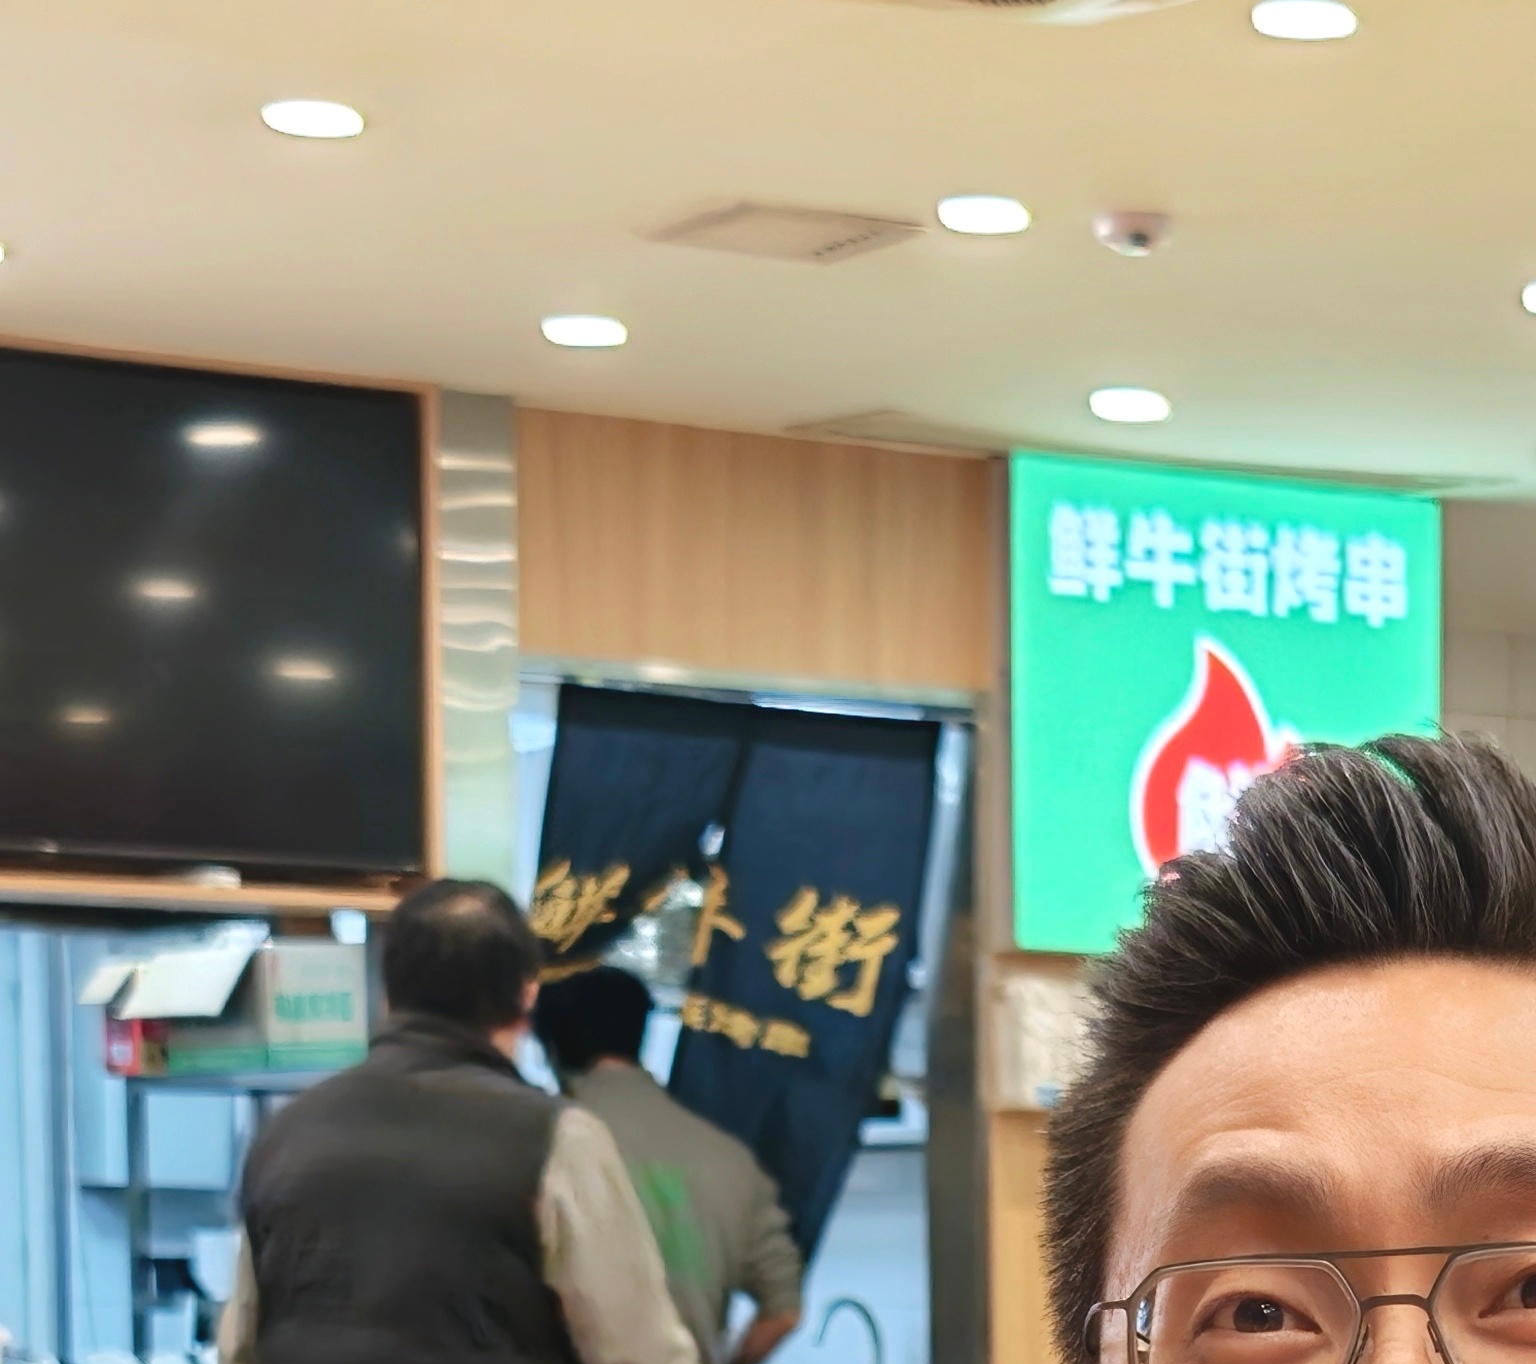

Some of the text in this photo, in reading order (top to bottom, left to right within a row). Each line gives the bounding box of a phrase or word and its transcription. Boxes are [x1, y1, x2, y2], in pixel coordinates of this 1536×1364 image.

[1048, 502, 1407, 626] 鲜牛街烤串
